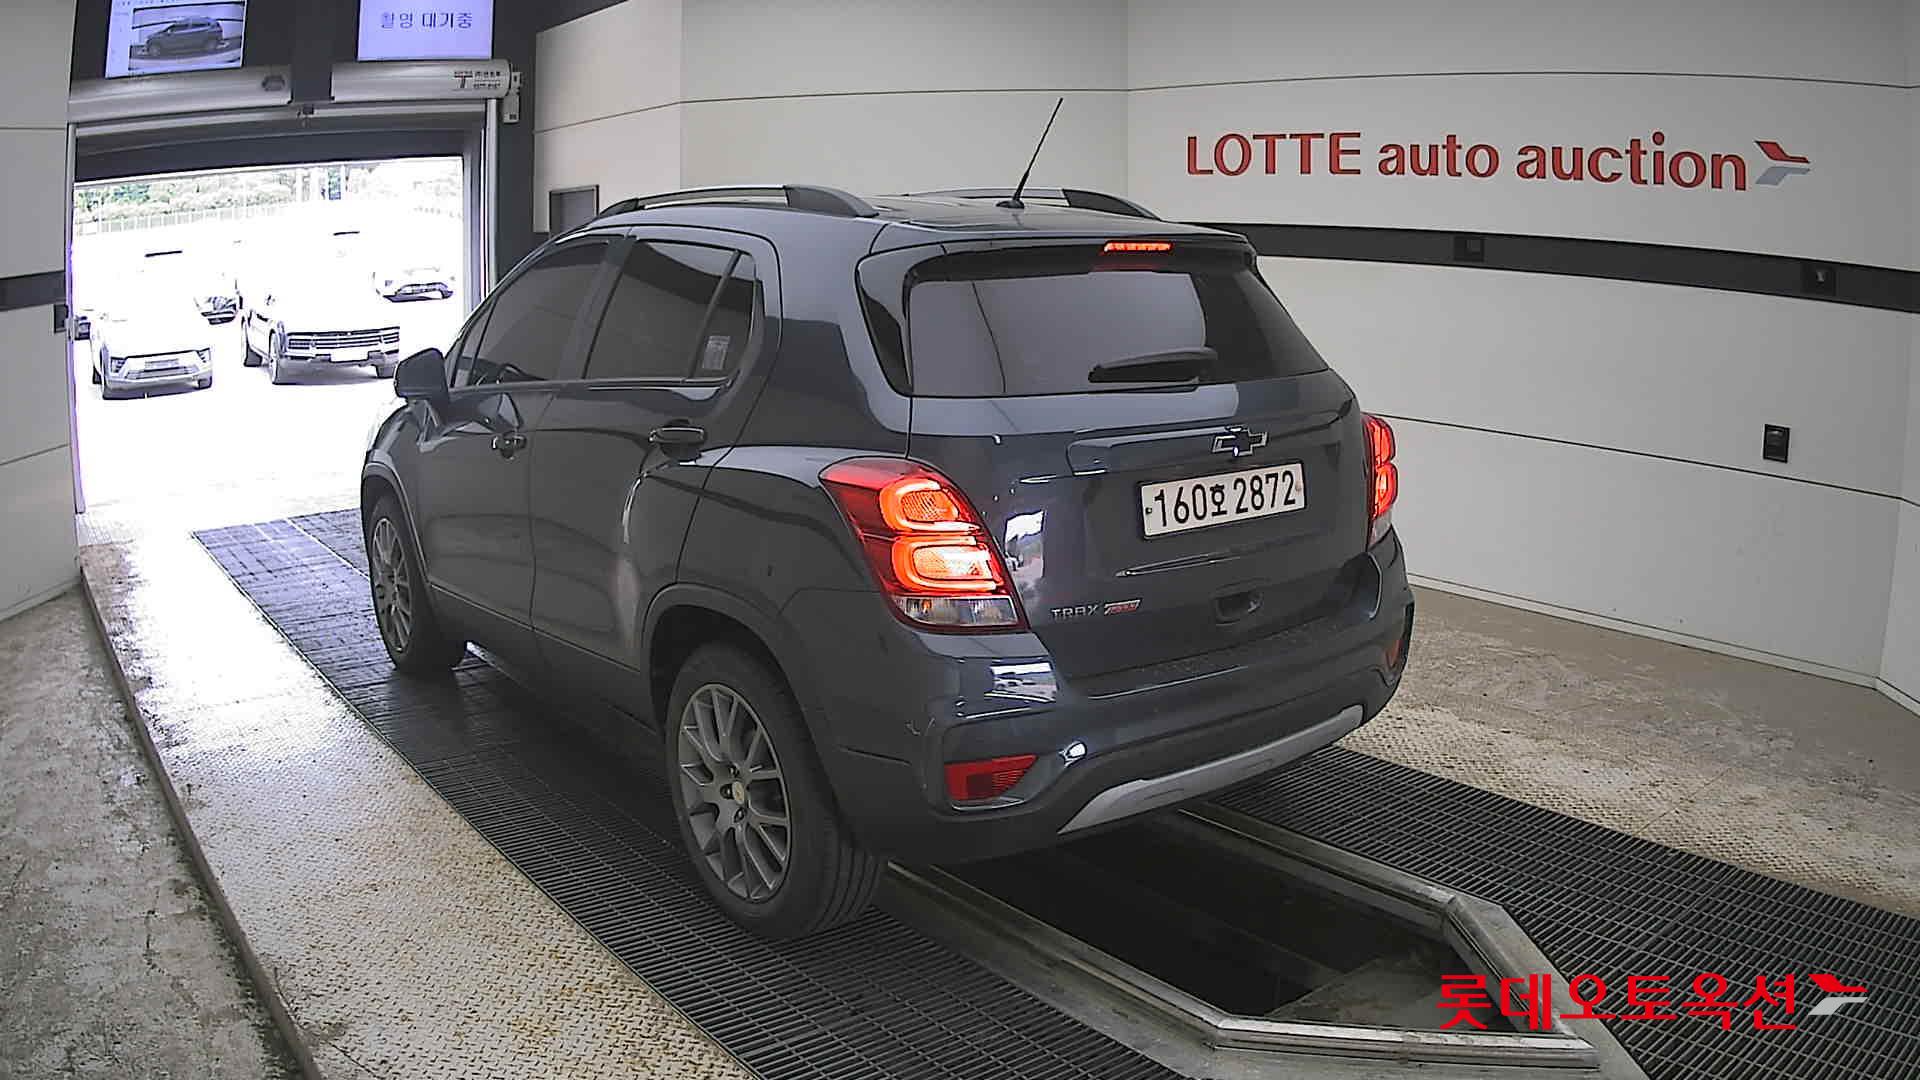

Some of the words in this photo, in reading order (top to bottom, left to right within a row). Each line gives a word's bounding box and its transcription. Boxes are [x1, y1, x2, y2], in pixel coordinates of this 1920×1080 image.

[422, 12, 472, 29] 대기중
[1186, 132, 1361, 177] LOTTE
[1377, 133, 1500, 178] auto
[1516, 131, 1748, 191] auction
[1154, 483, 1228, 528] 160호
[1233, 470, 1296, 514] 2872
[1051, 604, 1099, 619] TRAX
